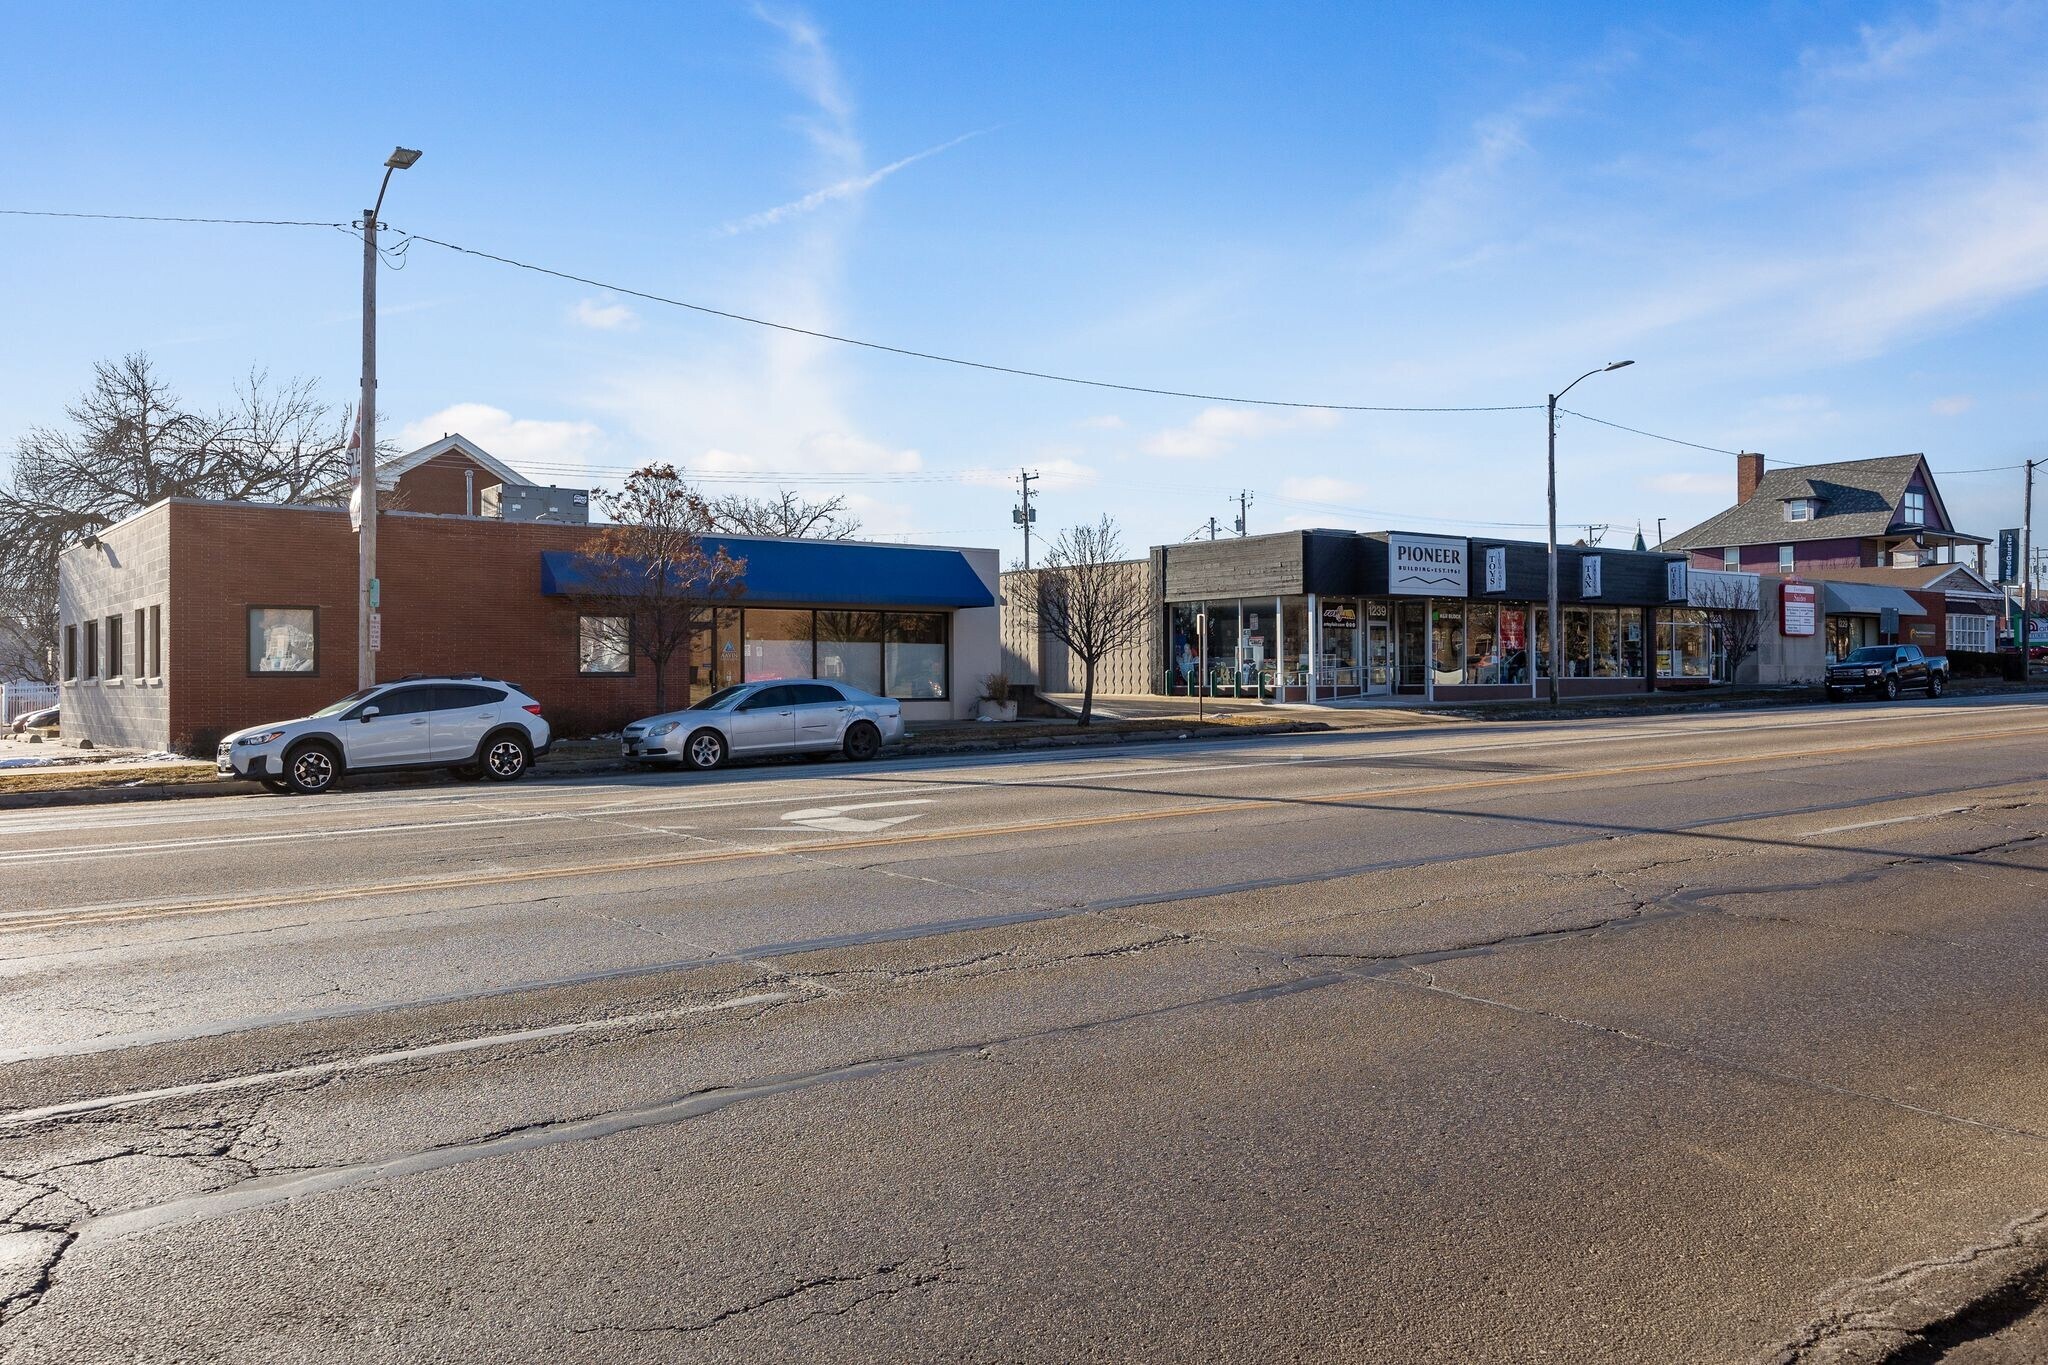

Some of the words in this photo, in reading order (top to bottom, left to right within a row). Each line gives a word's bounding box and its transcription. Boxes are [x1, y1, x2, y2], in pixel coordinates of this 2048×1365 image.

[1397, 545, 1461, 564] PIONEER
[1488, 555, 1496, 585] TOYS
[1585, 565, 1593, 590] TAX
[1368, 605, 1387, 616] 1239
